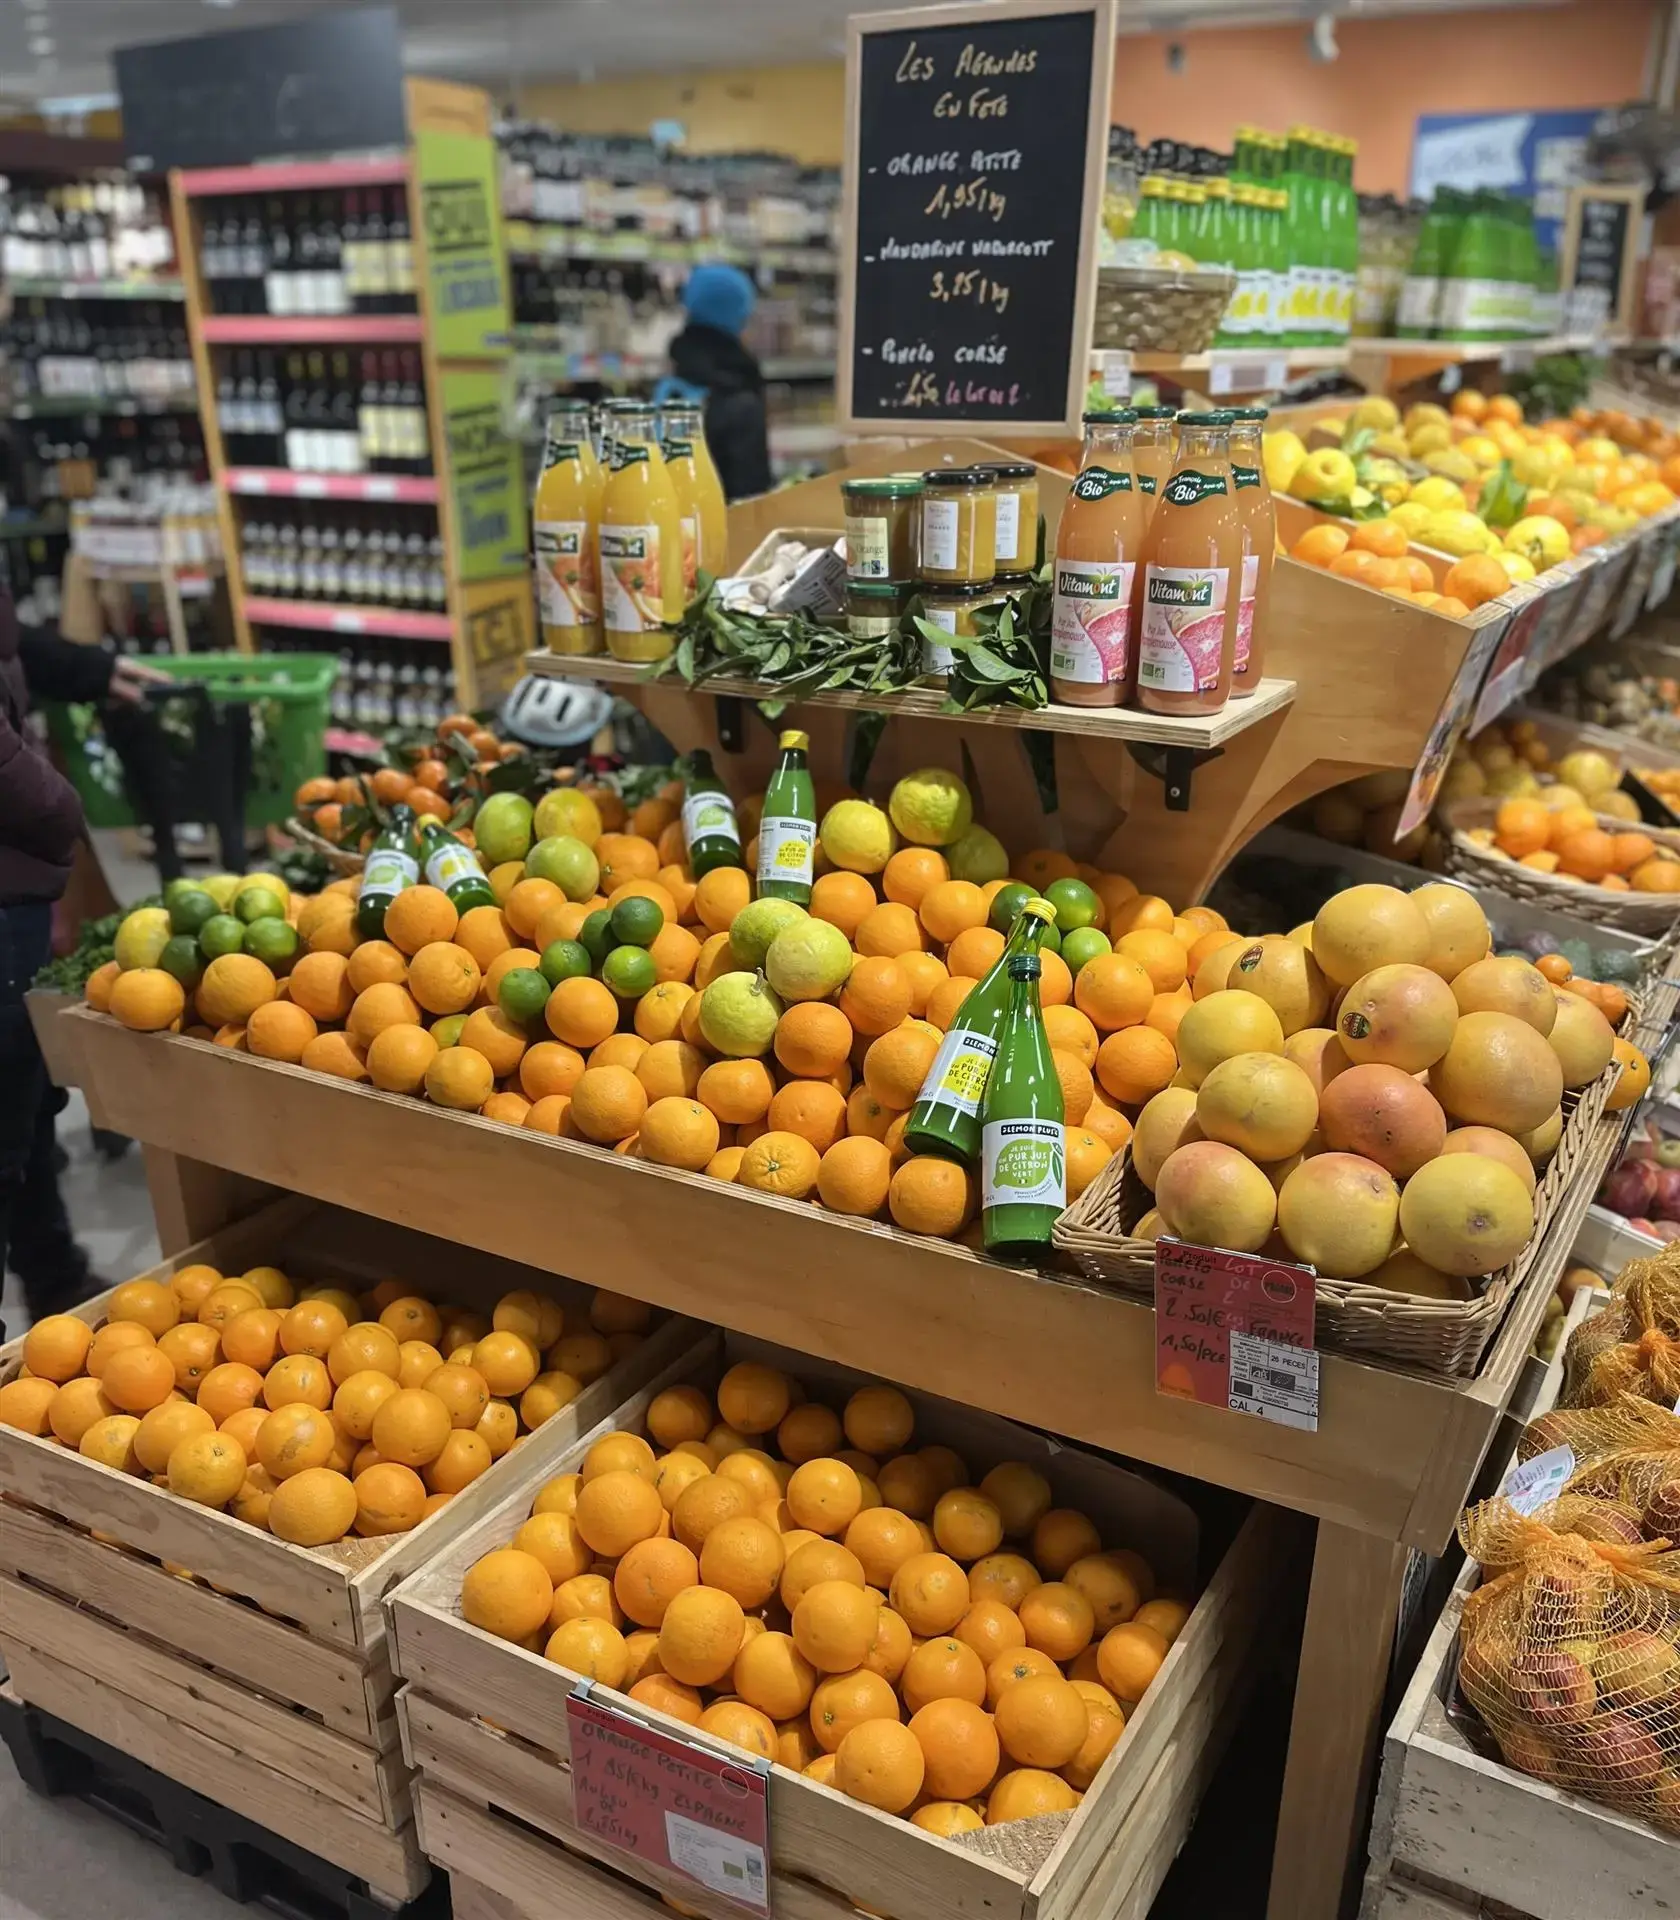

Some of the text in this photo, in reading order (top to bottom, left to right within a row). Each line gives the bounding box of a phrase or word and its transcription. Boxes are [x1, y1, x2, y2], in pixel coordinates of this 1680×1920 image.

[895, 41, 1038, 83] LES AGRUMES
[886, 150, 960, 176] ORANGE
[879, 237, 966, 261] MANDARINE
[953, 344, 1008, 365] CORSE
[1081, 479, 1104, 496] Bio
[1174, 484, 1198, 501] Bio
[1060, 572, 1117, 596] Vitamont
[1150, 580, 1210, 602] Vitamont
[969, 1040, 996, 1055] LEMON
[961, 1063, 979, 1074] PUR
[948, 1069, 987, 1087] DE CiTRO
[1007, 1125, 1055, 1135] LEMON PLUS
[1008, 1152, 1027, 1162] PUR
[1030, 1151, 1047, 1160] JUS
[999, 1163, 1009, 1173] DE
[1012, 1170, 1033, 1178] VERT
[1182, 1250, 1217, 1264] Produit
[1224, 1257, 1265, 1276] LOT
[1160, 1271, 1206, 1291] CORSE
[1229, 1398, 1264, 1416] CAL 4
[581, 1722, 651, 1760] ORANGE
[673, 1792, 746, 1833] ESPAGNE
